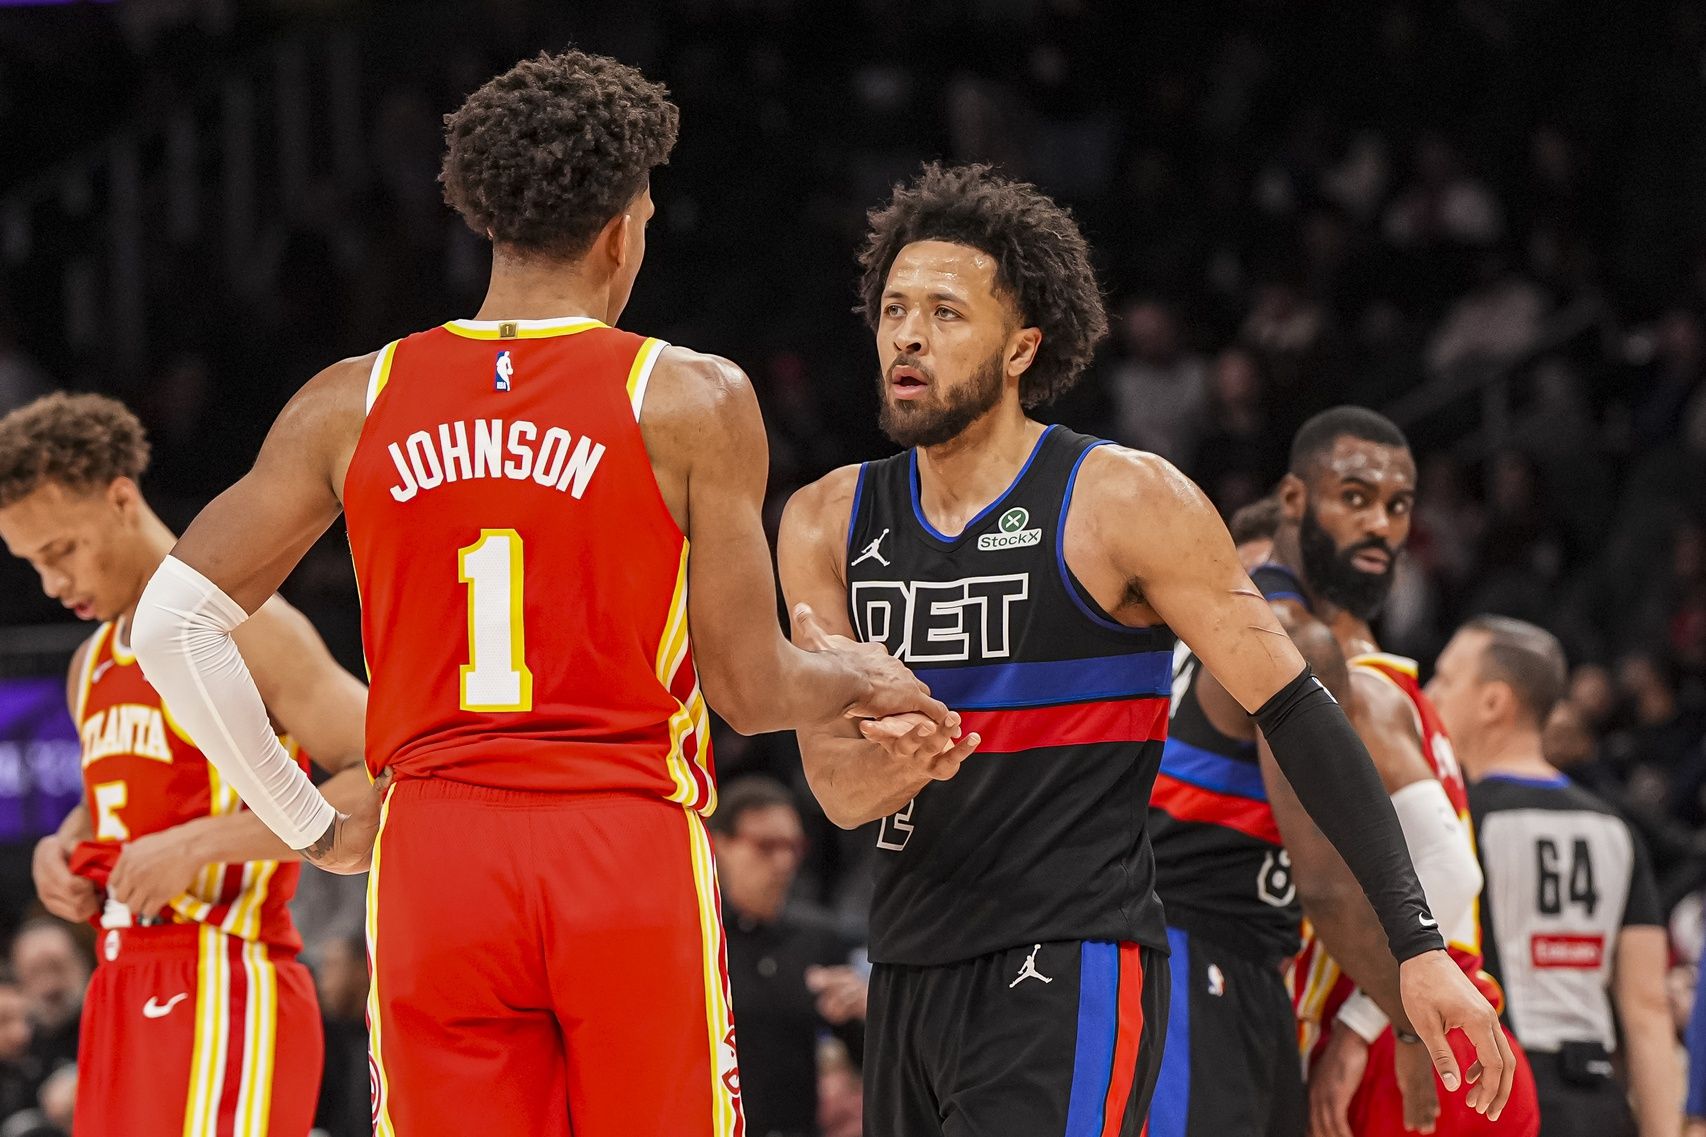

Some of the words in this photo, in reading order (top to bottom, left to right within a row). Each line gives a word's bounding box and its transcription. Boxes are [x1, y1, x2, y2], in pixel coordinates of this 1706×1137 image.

[388, 419, 606, 502] JOHNSON
[980, 530, 1040, 548] StockX
[458, 528, 533, 712] 1
[852, 572, 1029, 662] DET
[81, 703, 174, 767] TLANTA
[1535, 838, 1598, 916] 64
